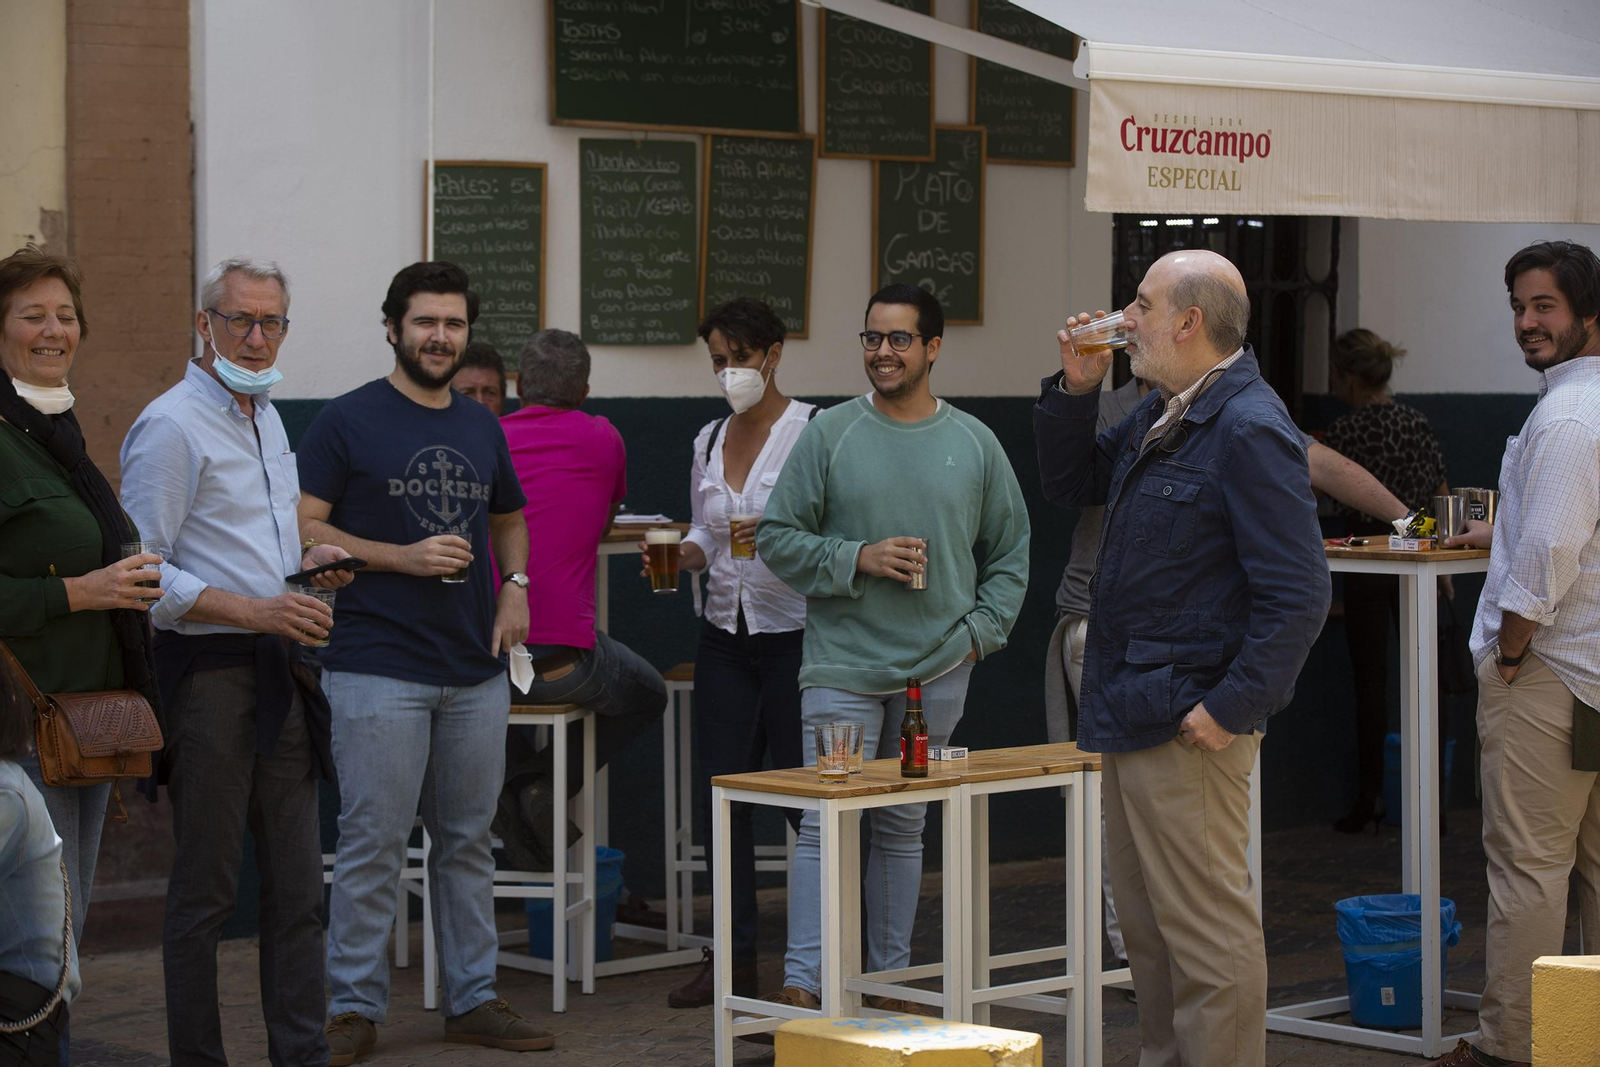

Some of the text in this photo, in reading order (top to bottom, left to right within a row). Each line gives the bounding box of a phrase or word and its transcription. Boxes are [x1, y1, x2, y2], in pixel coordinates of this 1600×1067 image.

[1120, 115, 1271, 163] Cruzcampo
[1147, 166, 1242, 191] ESPECIAL
[918, 209, 951, 234] DE
[418, 462, 465, 477] S F
[388, 478, 490, 502] DOCKERS
